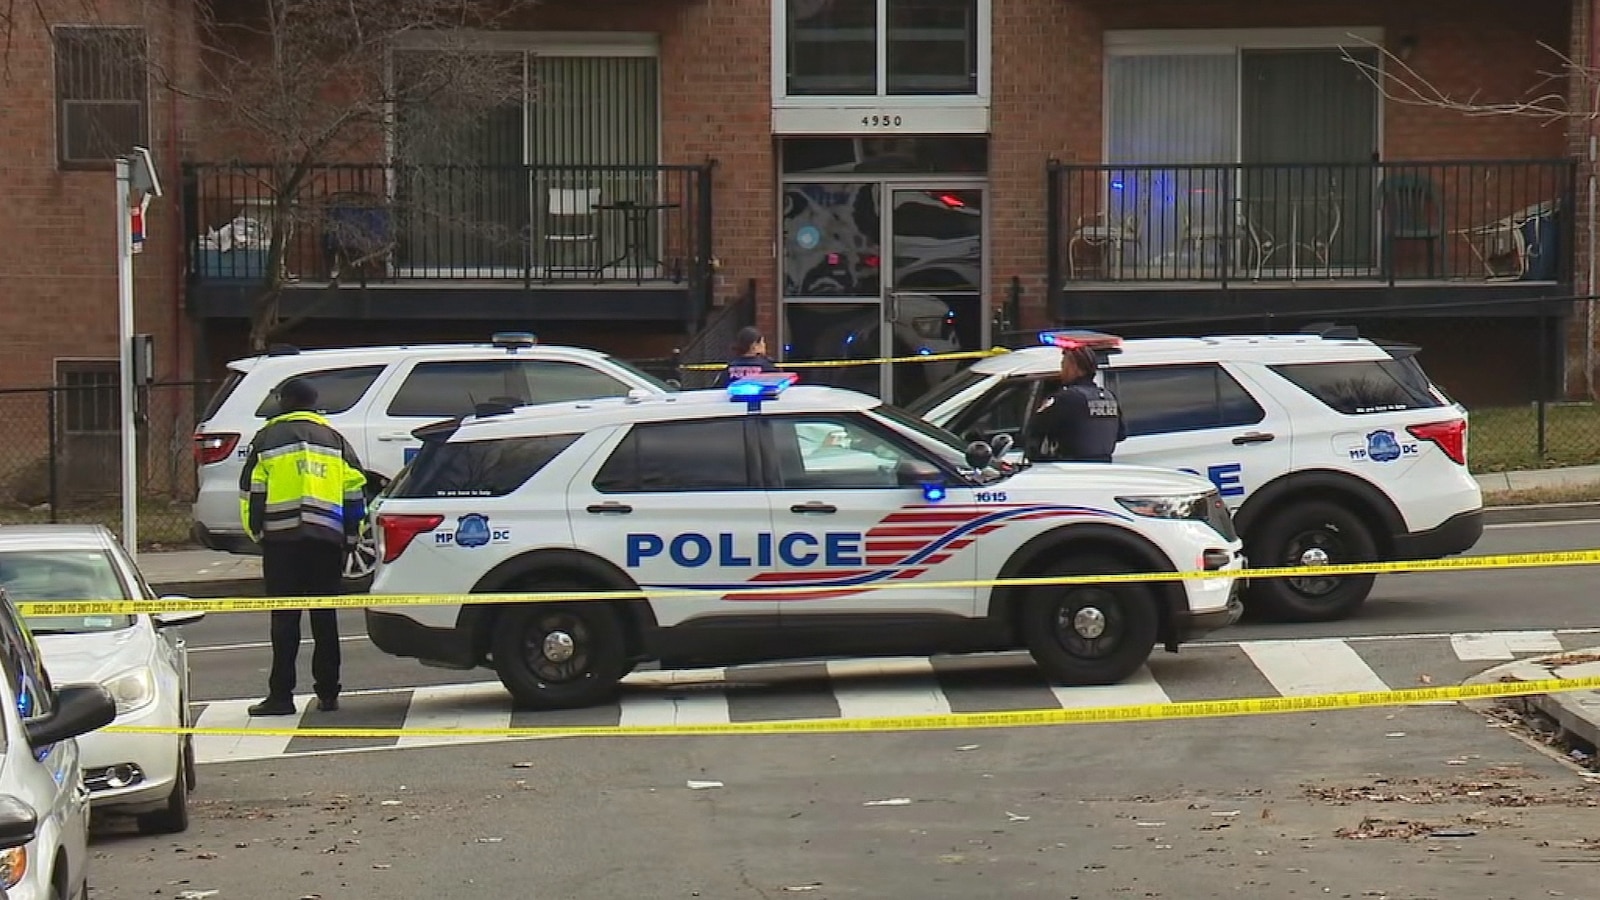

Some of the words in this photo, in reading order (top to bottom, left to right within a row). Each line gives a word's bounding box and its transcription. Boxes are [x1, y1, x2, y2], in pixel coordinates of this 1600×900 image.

[861, 115, 902, 126] 4950
[1349, 450, 1366, 459] MP
[1402, 444, 1418, 453] DC
[295, 459, 329, 479] POLICE
[976, 492, 1007, 502] 1615
[435, 533, 453, 543] MP
[493, 531, 509, 540] DC
[626, 532, 862, 568] POLICE
[92, 603, 112, 612] POLICE
